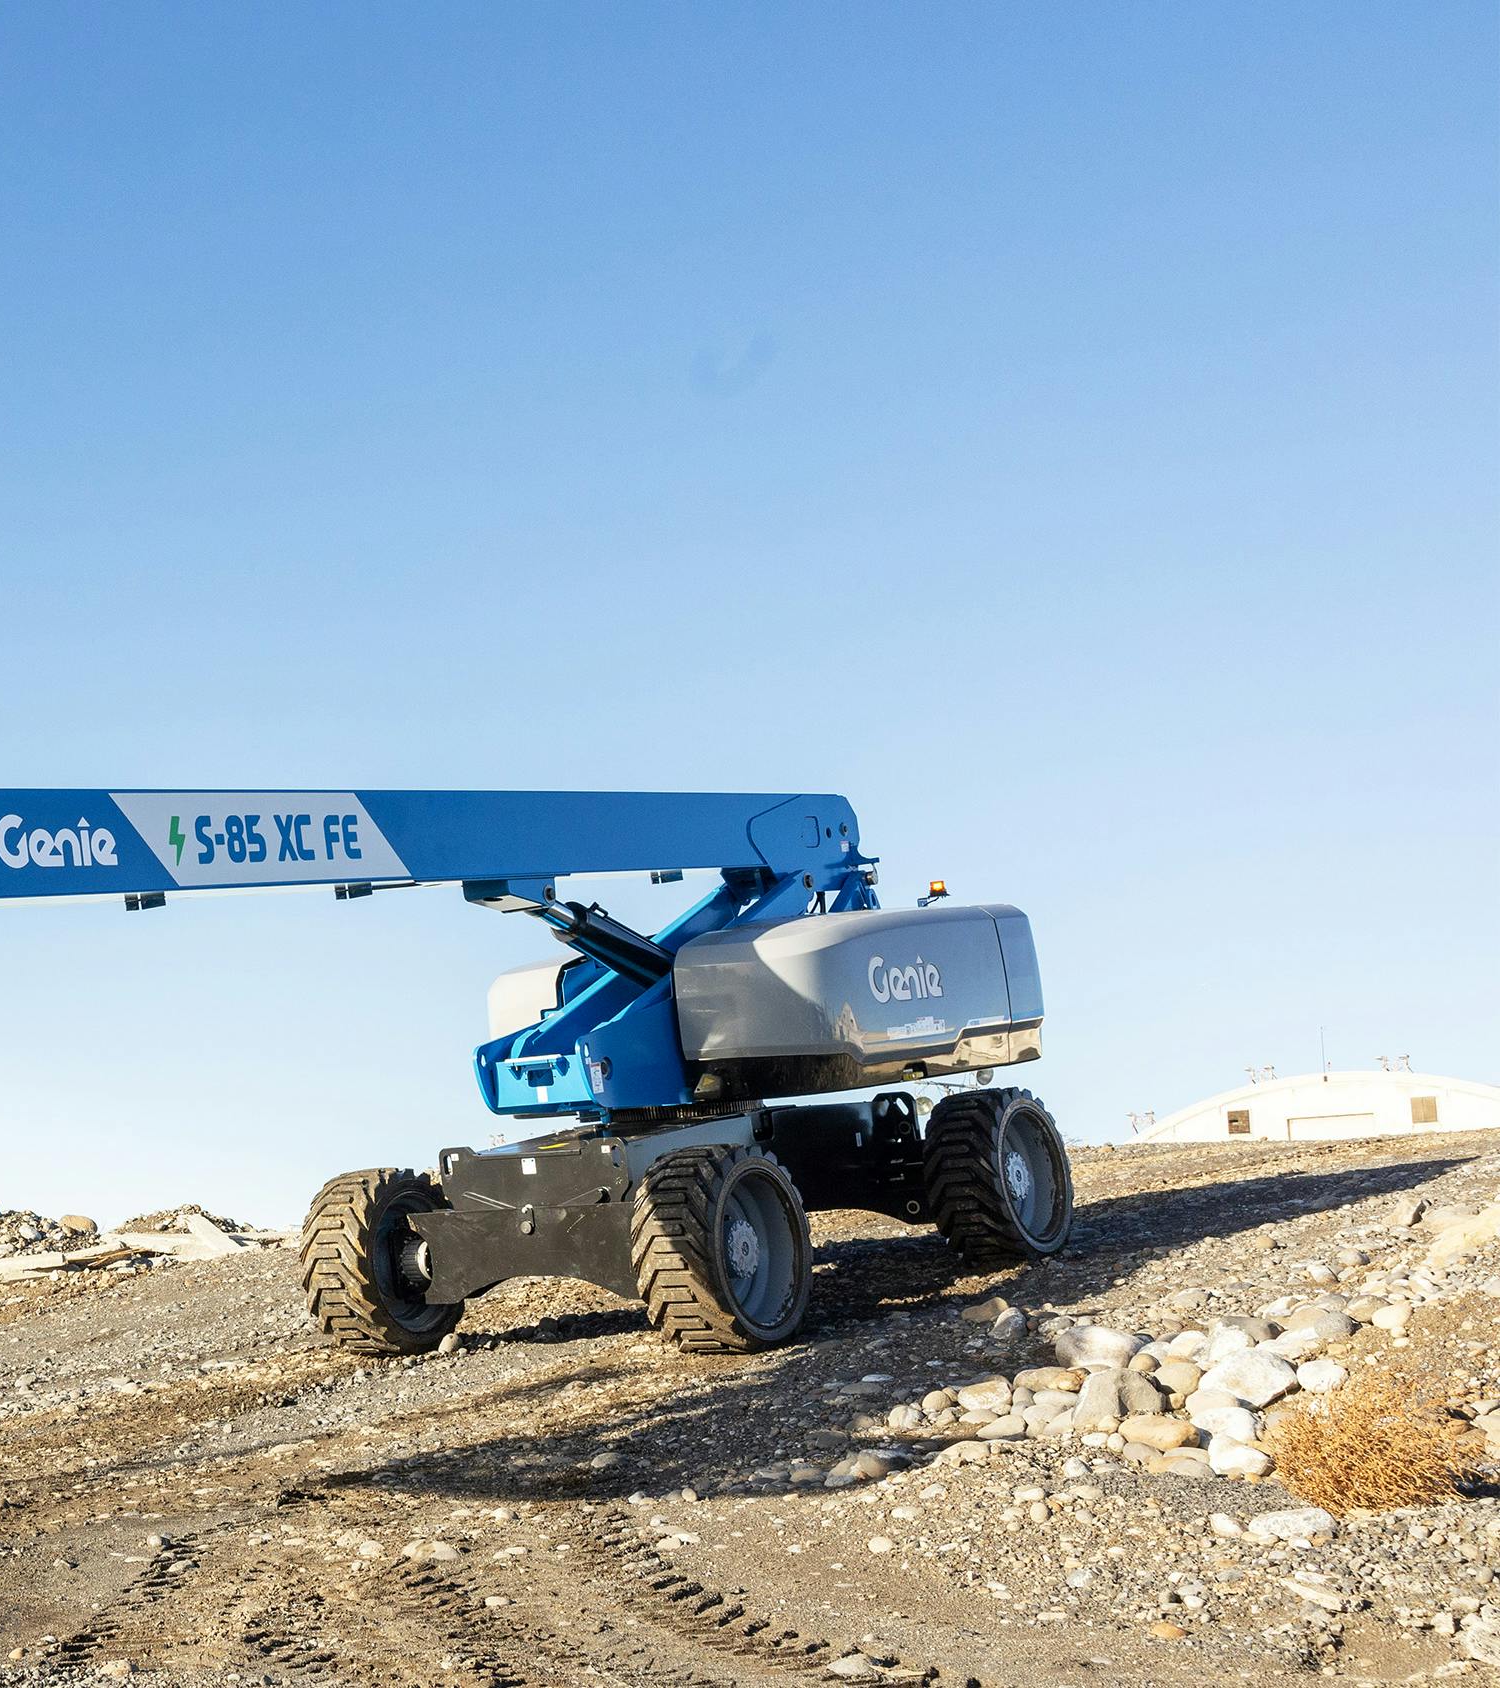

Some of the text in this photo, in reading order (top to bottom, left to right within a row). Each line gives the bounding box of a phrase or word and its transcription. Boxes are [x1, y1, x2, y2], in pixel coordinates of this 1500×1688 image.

[195, 814, 362, 864] S-85 XC FE
[868, 954, 943, 1003] Genie
